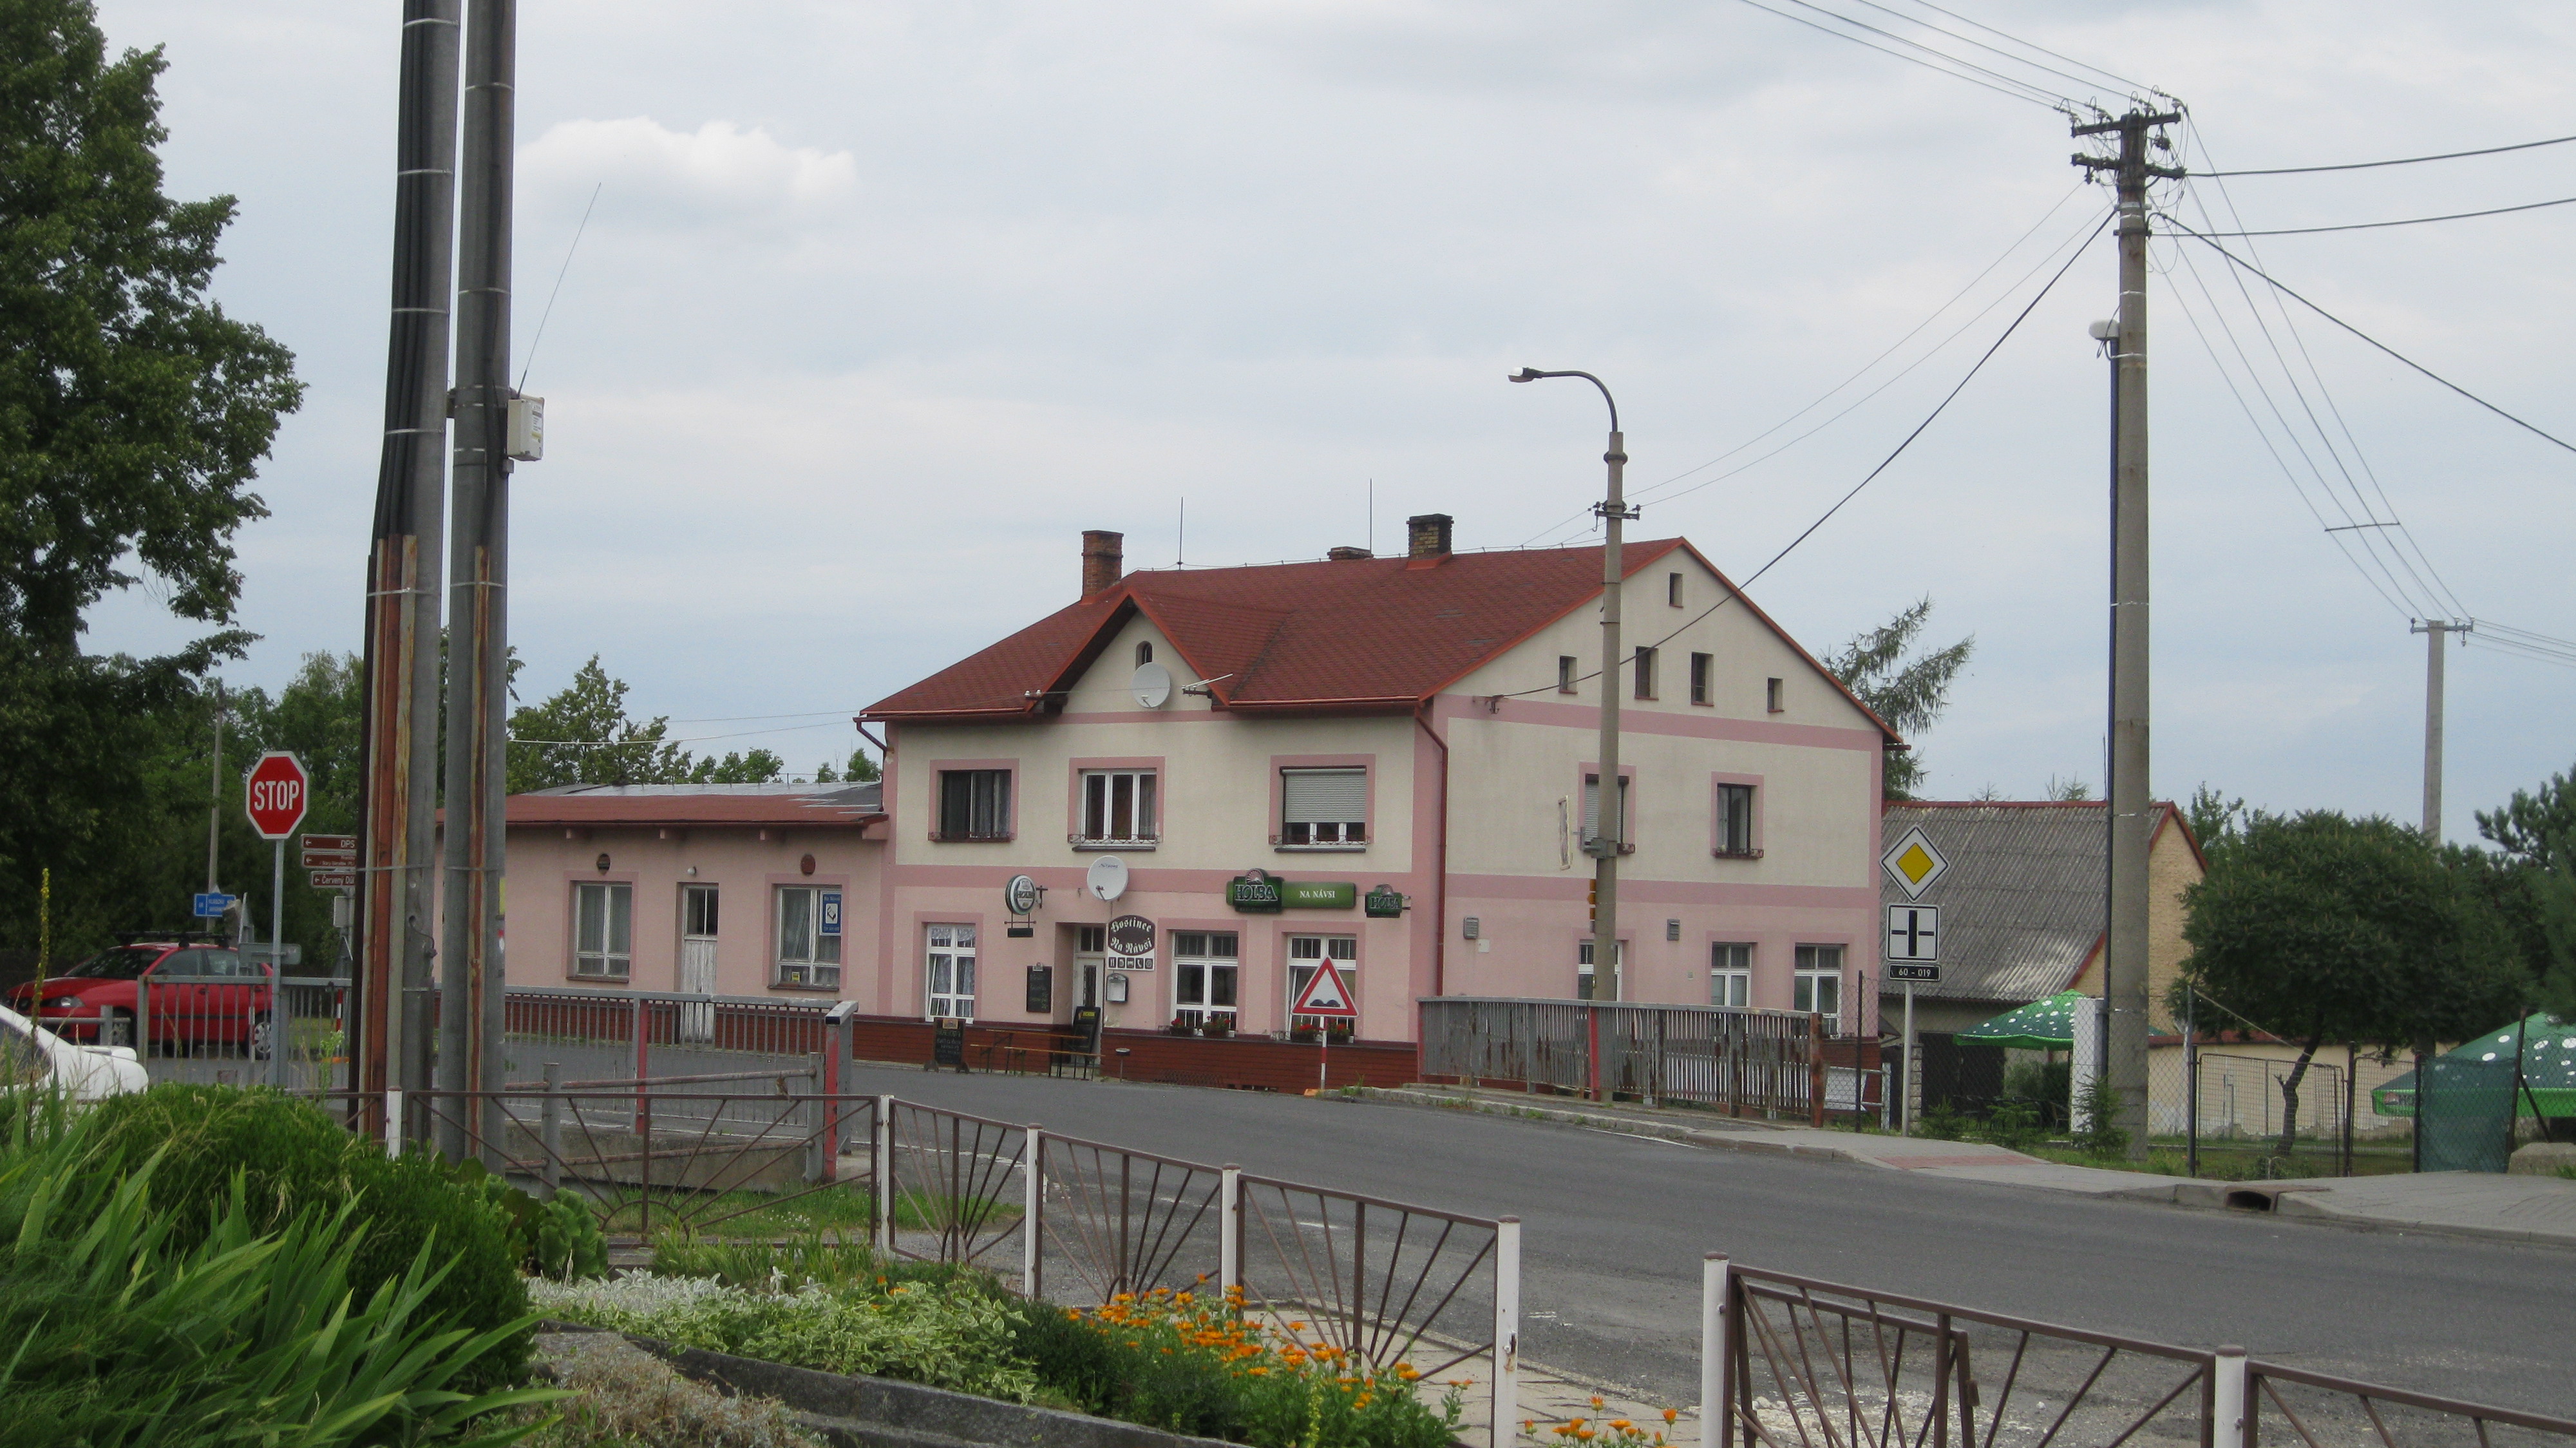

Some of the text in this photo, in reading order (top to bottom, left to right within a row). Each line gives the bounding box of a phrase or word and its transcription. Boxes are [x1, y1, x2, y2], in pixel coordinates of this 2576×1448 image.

[254, 780, 299, 810] STOP
[340, 839, 355, 848] DPS
[1234, 884, 1278, 901] HOLBA
[1312, 889, 1336, 899] NÁVSI
[1370, 896, 1401, 910] HOLBA
[1110, 917, 1152, 933] Hostinec
[1110, 937, 1123, 951] Na
[1899, 967, 1908, 976] 60
